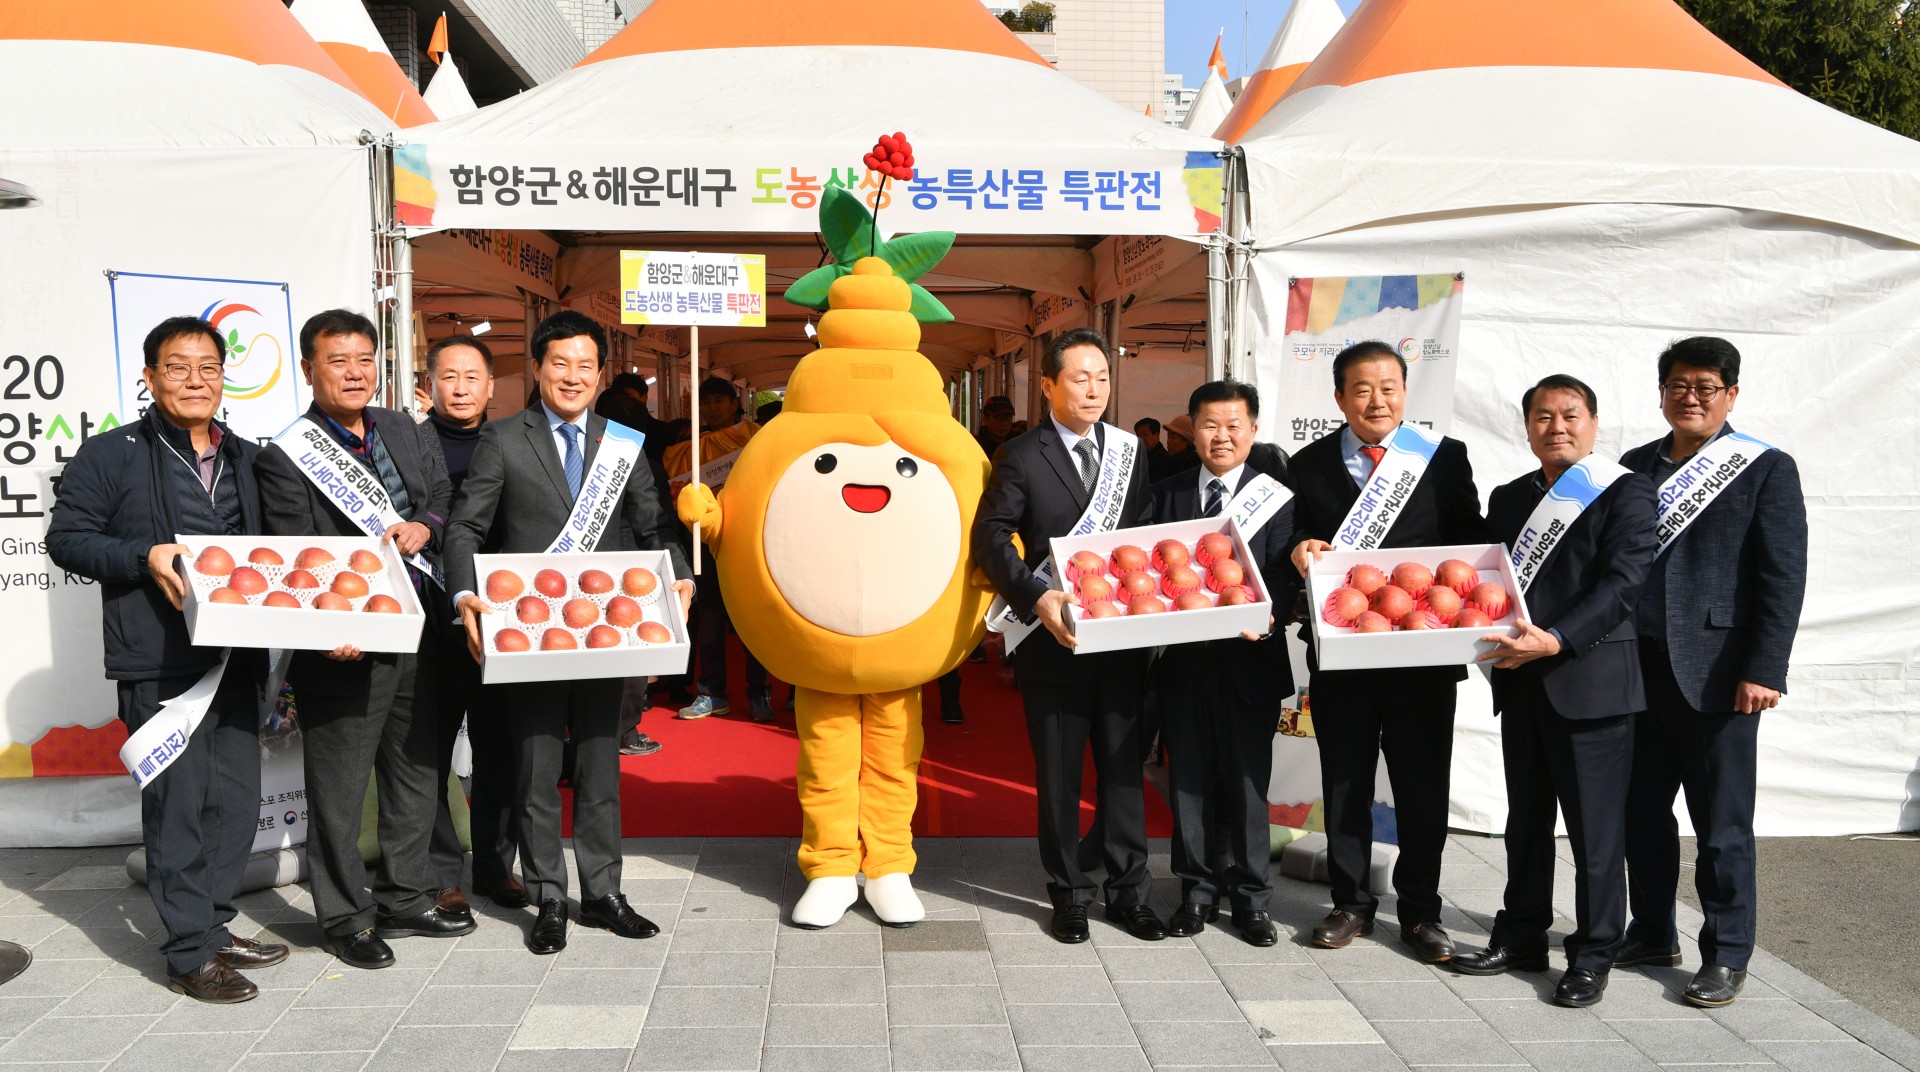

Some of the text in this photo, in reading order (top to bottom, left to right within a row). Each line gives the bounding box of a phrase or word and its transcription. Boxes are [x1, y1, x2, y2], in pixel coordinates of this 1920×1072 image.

[450, 164, 737, 207] 함양군&해운대구
[907, 168, 1048, 210] 농특산물
[1059, 170, 1161, 211] 특판전
[625, 290, 673, 313] 도농상생
[676, 291, 723, 314] 농특산물
[726, 293, 762, 314] 특판전
[647, 262, 739, 287] 함양군&해운대구
[1292, 346, 1316, 357] 굿모닝
[0, 475, 62, 518] 노
[299, 452, 365, 514] 도농상생
[550, 463, 609, 553] 도농상생 농
[578, 457, 630, 553] 함양군&해운대
[1073, 448, 1119, 536] 도농상생 농
[1099, 441, 1134, 533] 함양군&해운대
[1340, 475, 1390, 545] 도농상생
[1355, 469, 1417, 550] 함양군&해운
[1512, 527, 1538, 573] 도농
[138, 729, 187, 778] 특판전
